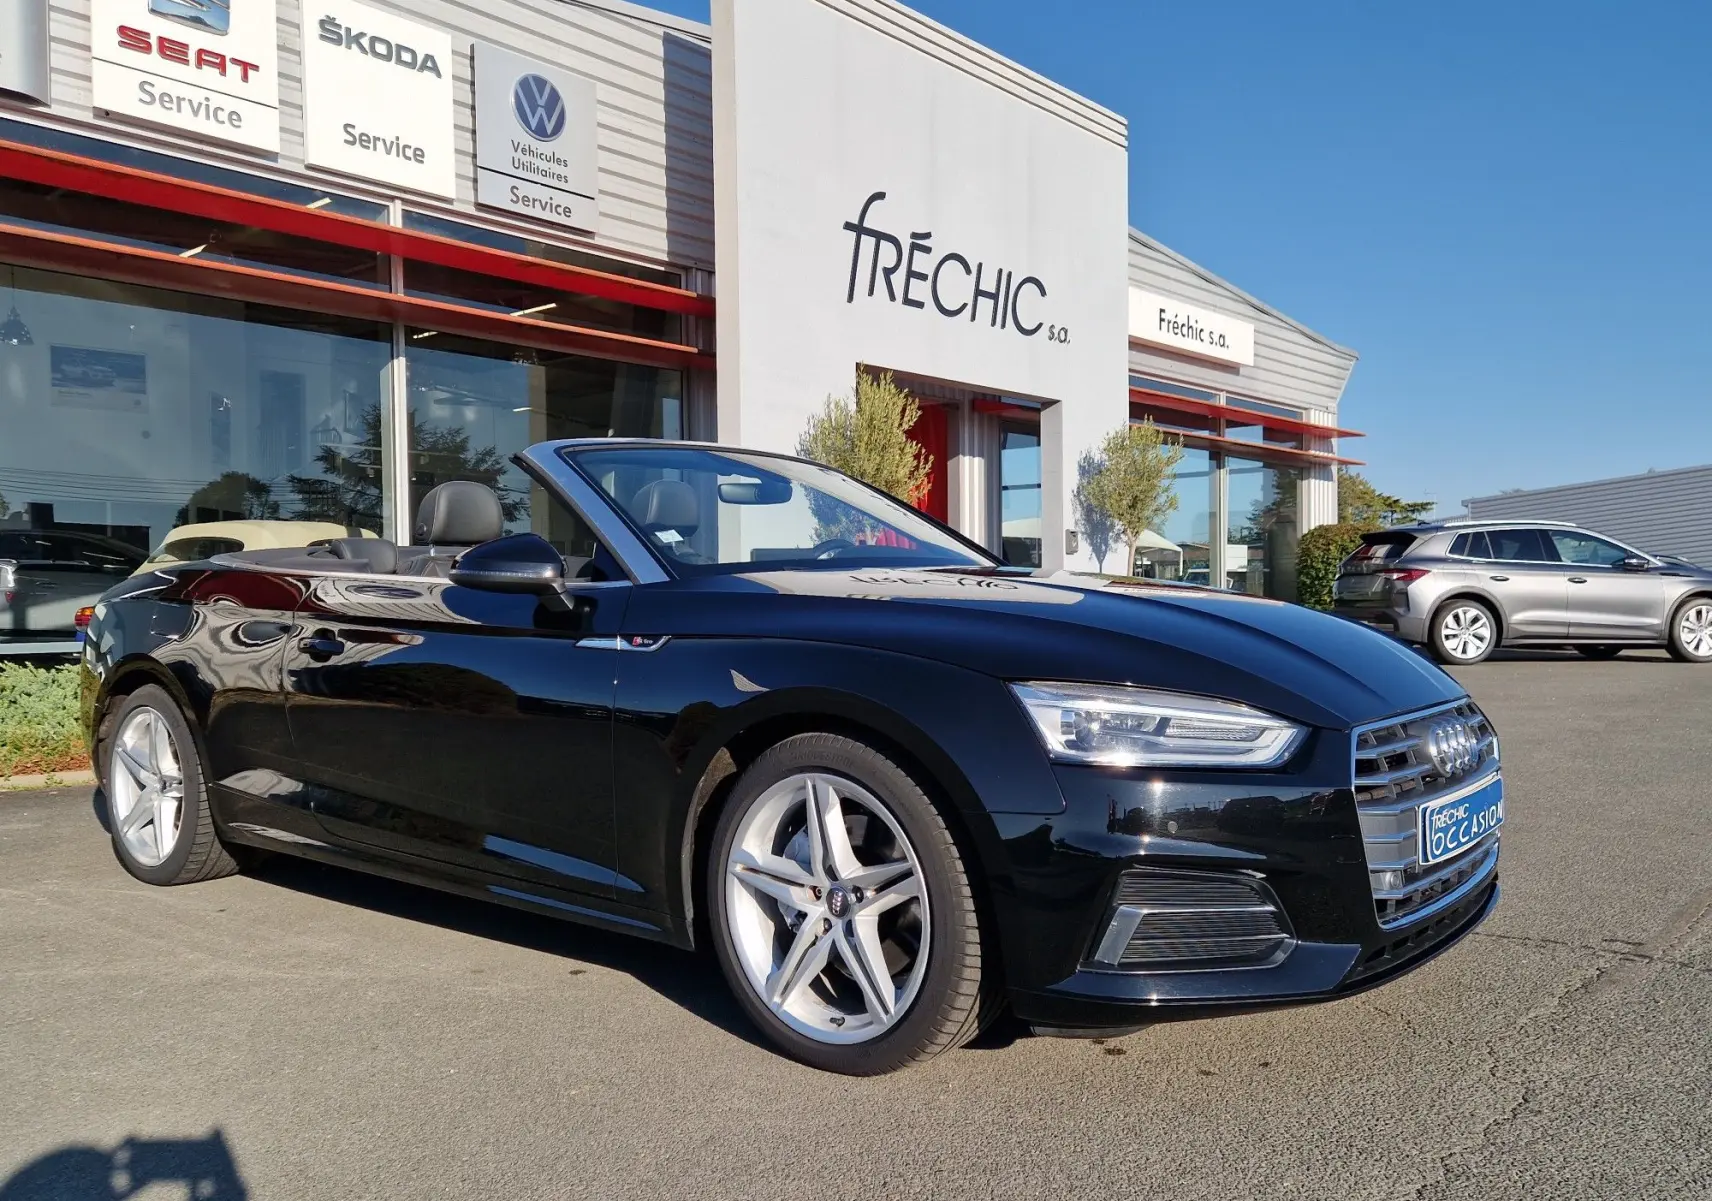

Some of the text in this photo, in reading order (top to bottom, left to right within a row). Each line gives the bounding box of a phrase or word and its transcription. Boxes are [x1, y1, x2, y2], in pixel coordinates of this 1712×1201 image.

[116, 24, 260, 84] SEAT
[318, 14, 442, 79] ŠKODA
[138, 80, 243, 129] Service
[342, 122, 426, 165] Service
[511, 138, 569, 168] Véhicules
[511, 156, 570, 184] Utilitaires
[509, 185, 573, 219] Service
[1158, 307, 1231, 350] Fréchic s.a.
[1432, 800, 1502, 856] OCCASION
